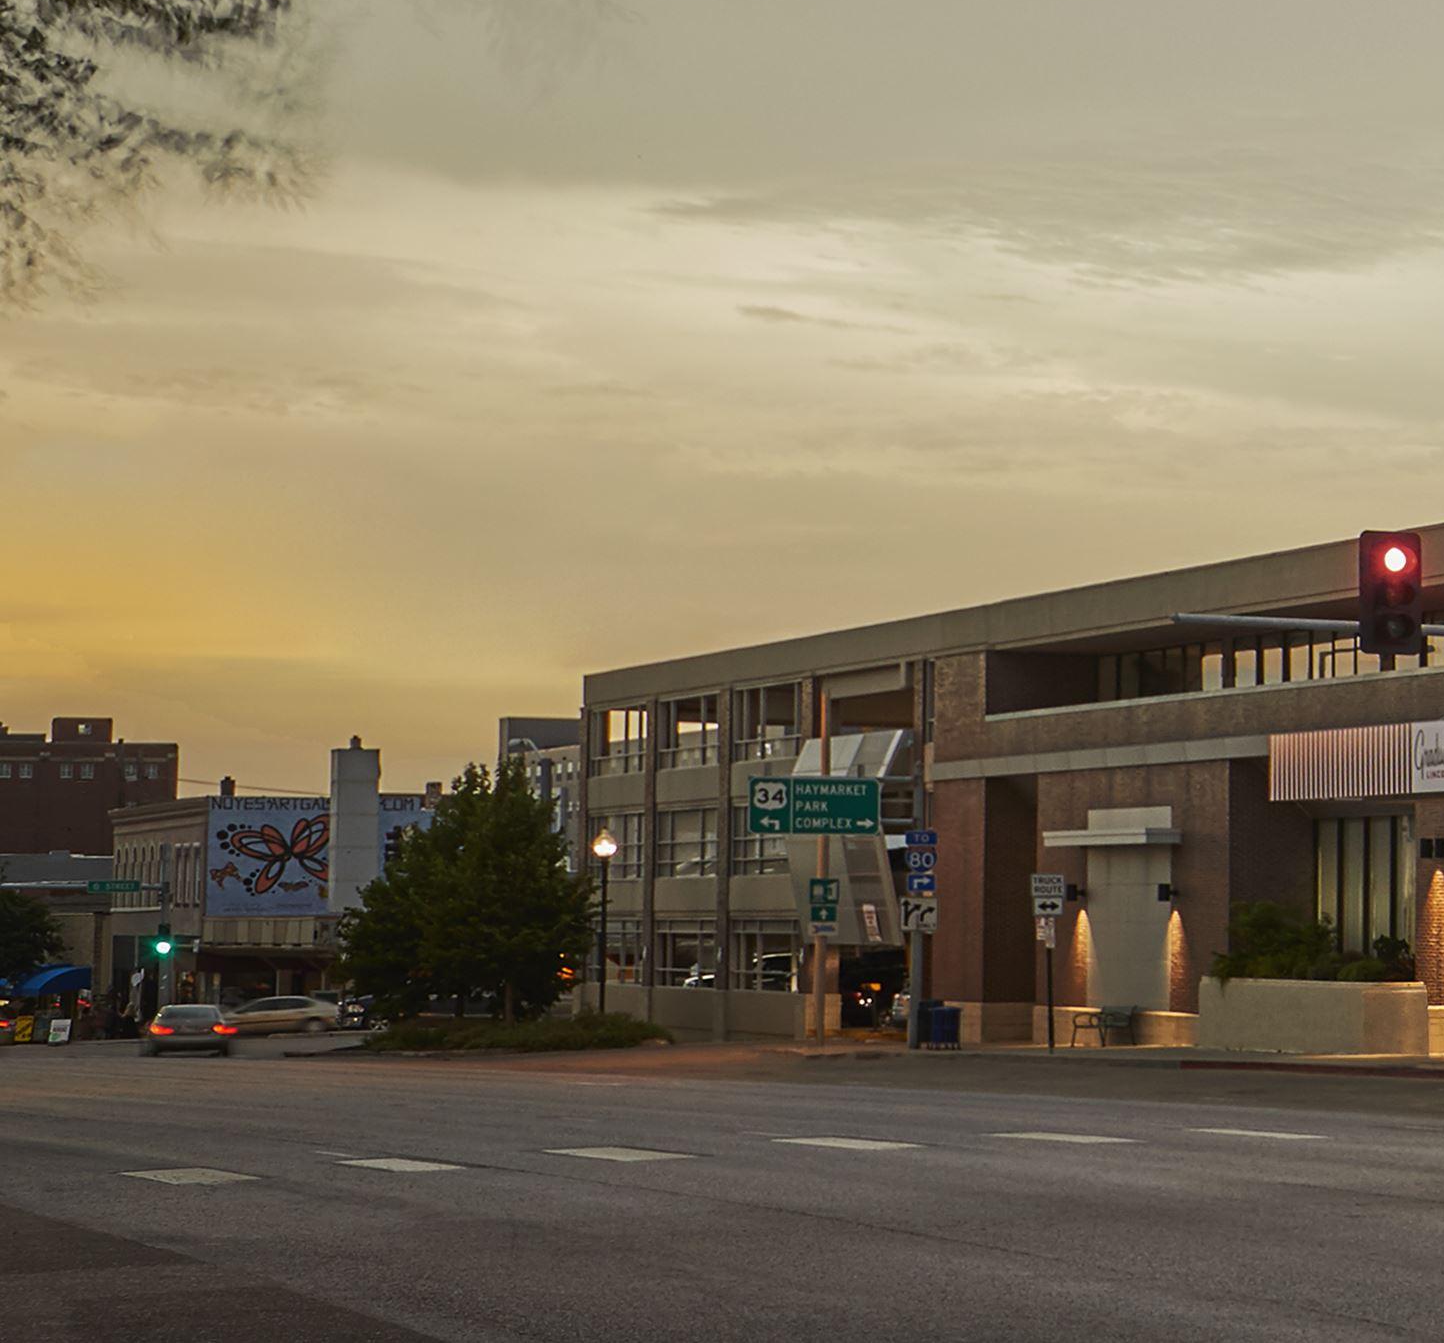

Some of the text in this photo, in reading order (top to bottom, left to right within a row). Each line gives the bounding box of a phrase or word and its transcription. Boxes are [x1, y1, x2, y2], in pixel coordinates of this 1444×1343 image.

[795, 784, 867, 795] HAYMARKET
[757, 788, 783, 804] 34
[795, 801, 828, 812] PARK
[795, 818, 852, 829] COMPLEX
[909, 853, 934, 868] 80
